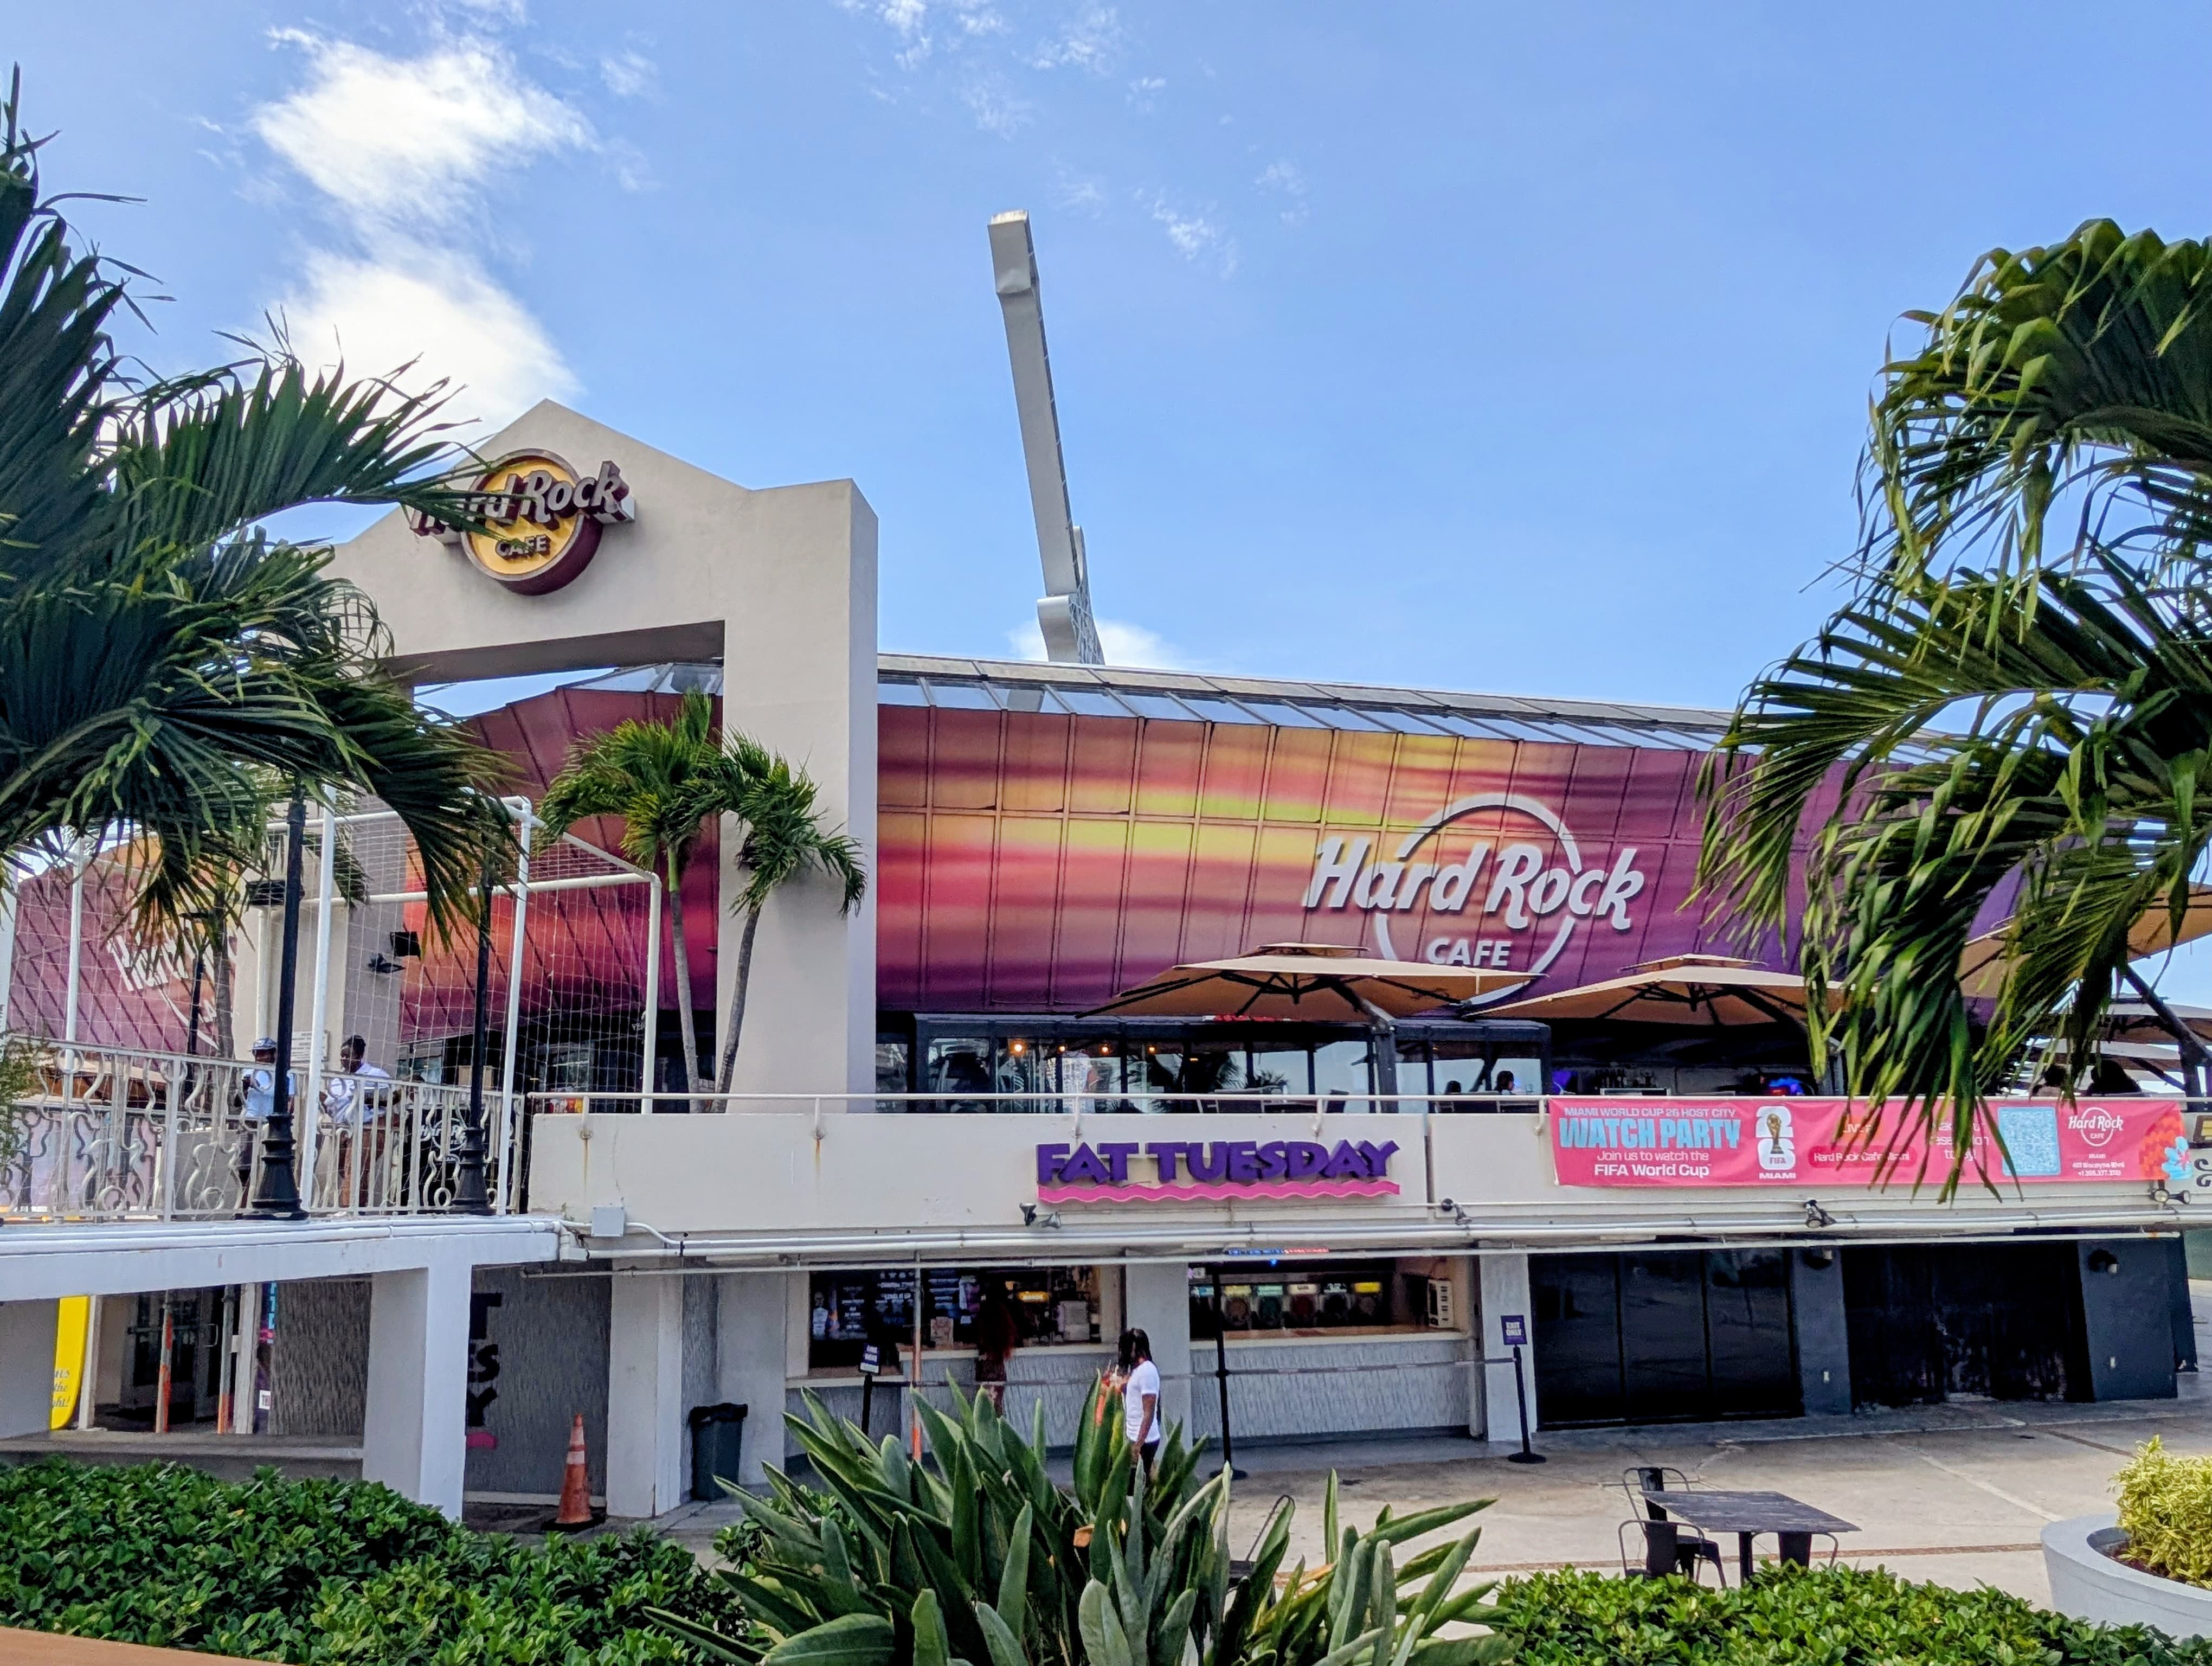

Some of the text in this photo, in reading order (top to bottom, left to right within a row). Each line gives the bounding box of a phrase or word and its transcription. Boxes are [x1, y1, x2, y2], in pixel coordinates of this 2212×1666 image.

[519, 460, 628, 529] Rock
[1302, 836, 1645, 930] Hard Rock
[1426, 937, 1513, 967] CAFE
[1600, 1108, 1639, 1116] WORLD
[1641, 1108, 1664, 1117] CUP
[1681, 1108, 1709, 1117] HOST
[1712, 1108, 1736, 1118] CITY
[2068, 1114, 2124, 1132] Hard Rock
[1559, 1118, 1741, 1149] WATCH PARTY
[1036, 1138, 1400, 1186] FAT TUESDAY
[1594, 1164, 1629, 1176] FIFA
[1631, 1164, 1676, 1176] World
[1597, 1150, 1709, 1161] Join us to watch the
